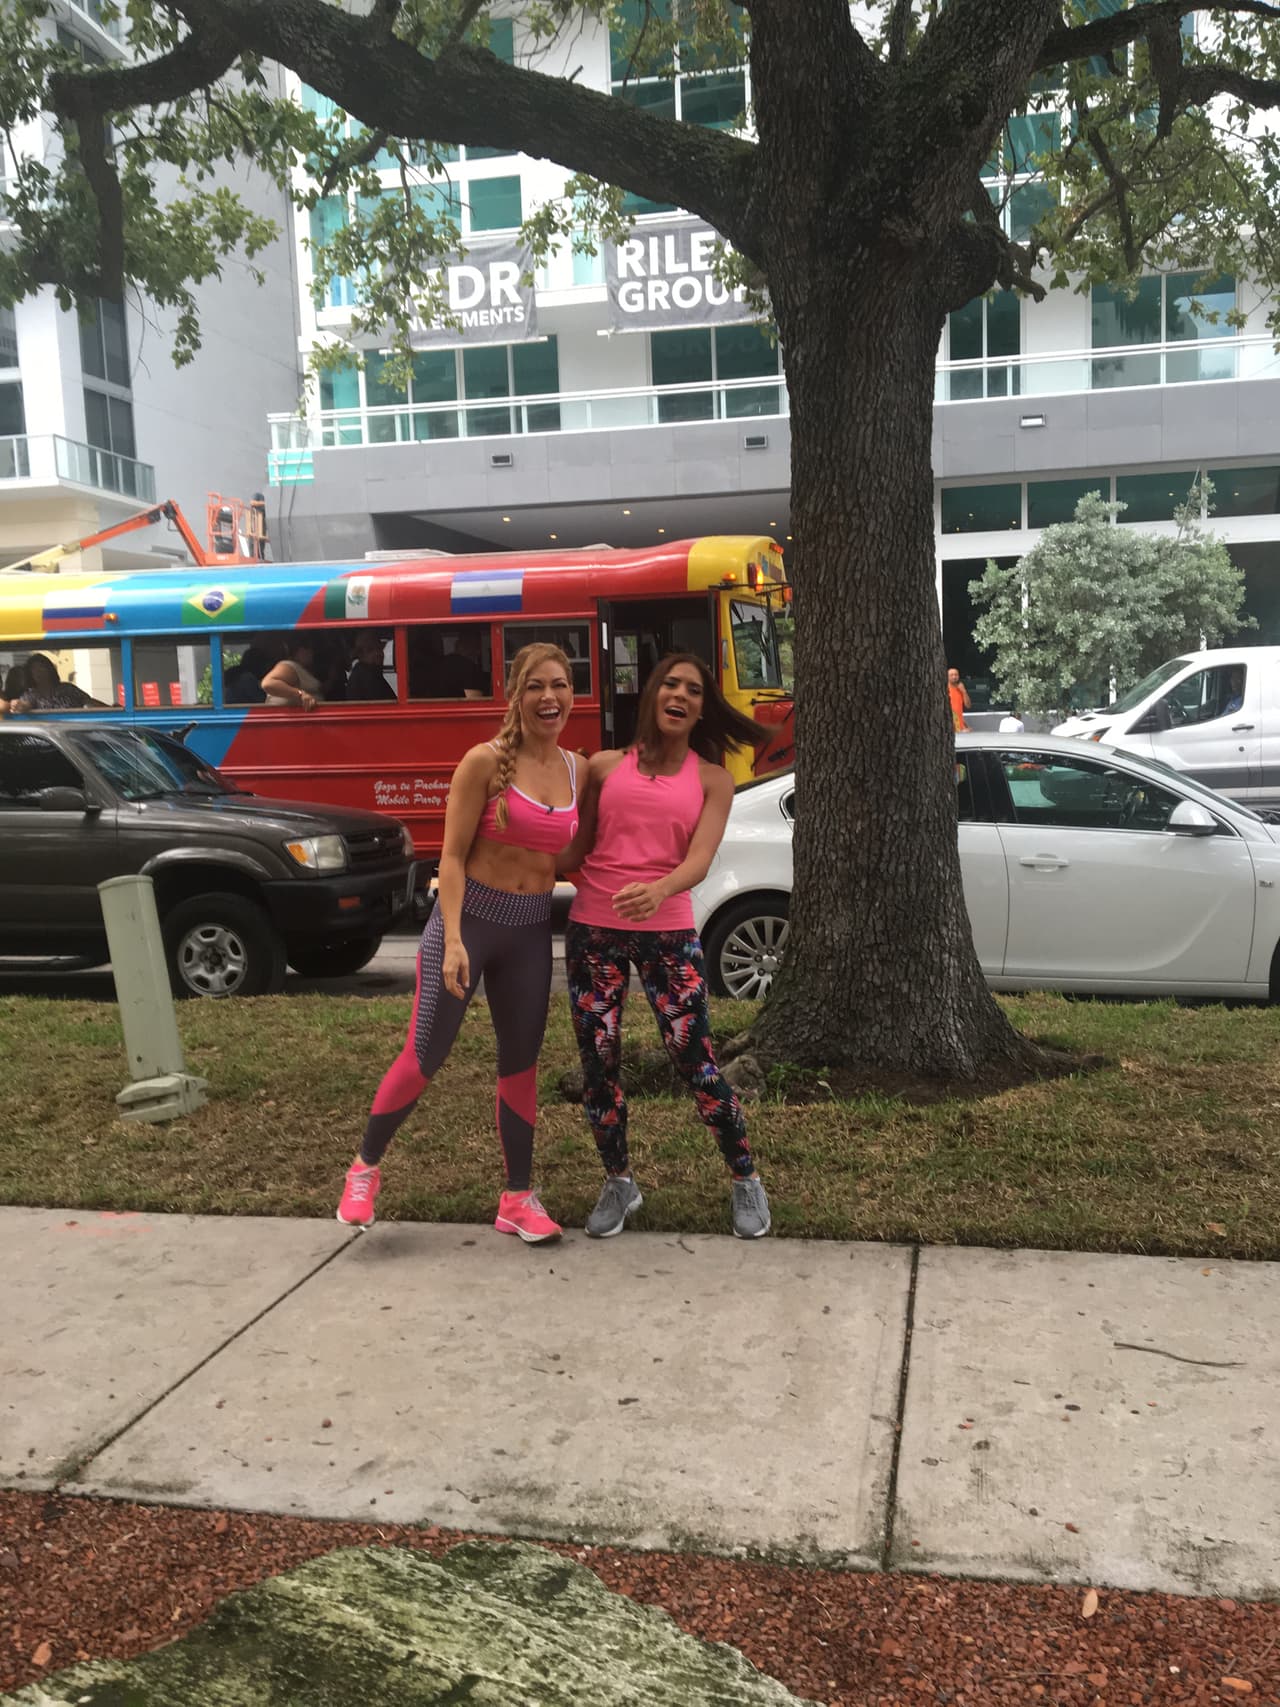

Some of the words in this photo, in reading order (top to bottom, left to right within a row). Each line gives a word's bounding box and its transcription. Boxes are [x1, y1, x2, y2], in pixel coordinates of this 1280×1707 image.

[399, 306, 525, 333] NVETMENTS
[375, 794, 409, 805] Mobile
[413, 793, 441, 806] Party
